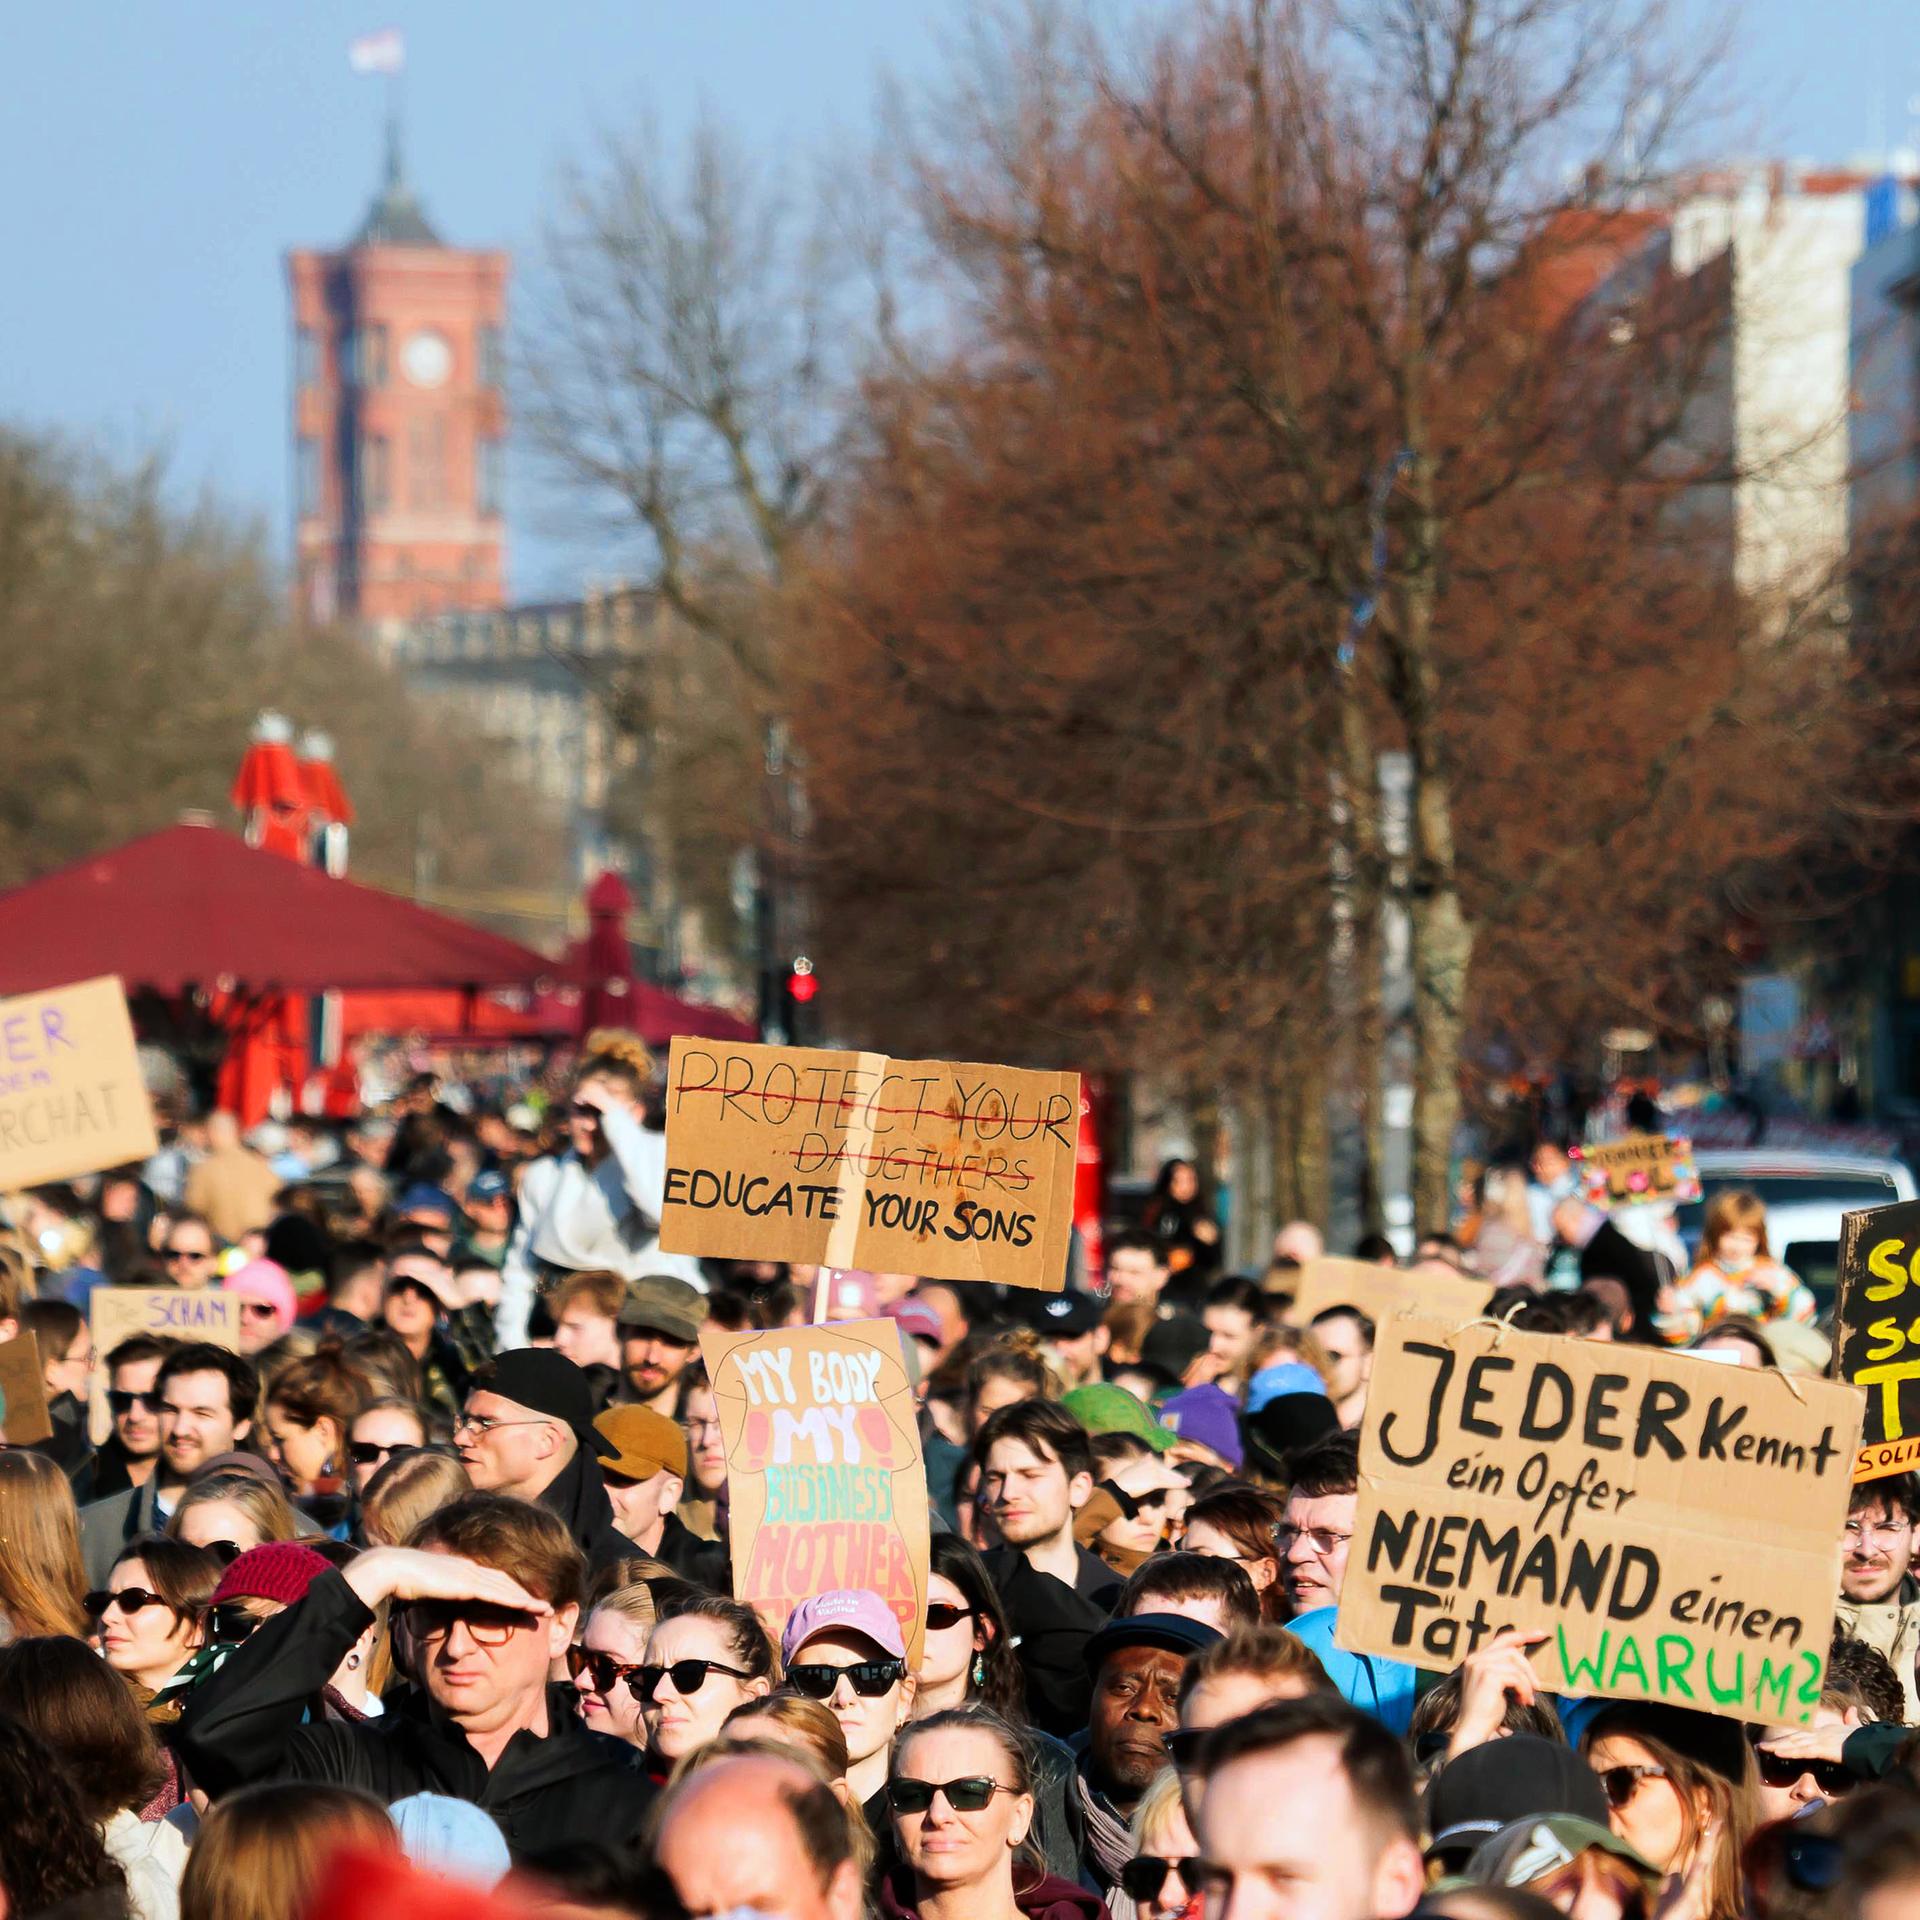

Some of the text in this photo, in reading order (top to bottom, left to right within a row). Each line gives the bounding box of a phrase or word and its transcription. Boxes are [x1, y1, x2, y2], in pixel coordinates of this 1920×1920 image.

[677, 1051, 1071, 1148] PROTECT YOUR
[794, 1133, 1031, 1191] DAUGTHERS
[664, 1168, 1036, 1247] EDUCATE YOUR SONS
[1865, 1239, 1920, 1302] S
[146, 1295, 226, 1328] SCHAM
[733, 1347, 882, 1404] MY BODY
[1380, 1342, 1691, 1466] JEDER
[1447, 1450, 1635, 1539] ein Opfer
[746, 1523, 917, 1597] MOTHER
[1367, 1510, 1801, 1647] NIEMAND einen
[1557, 1624, 1822, 1727] WARUM?
